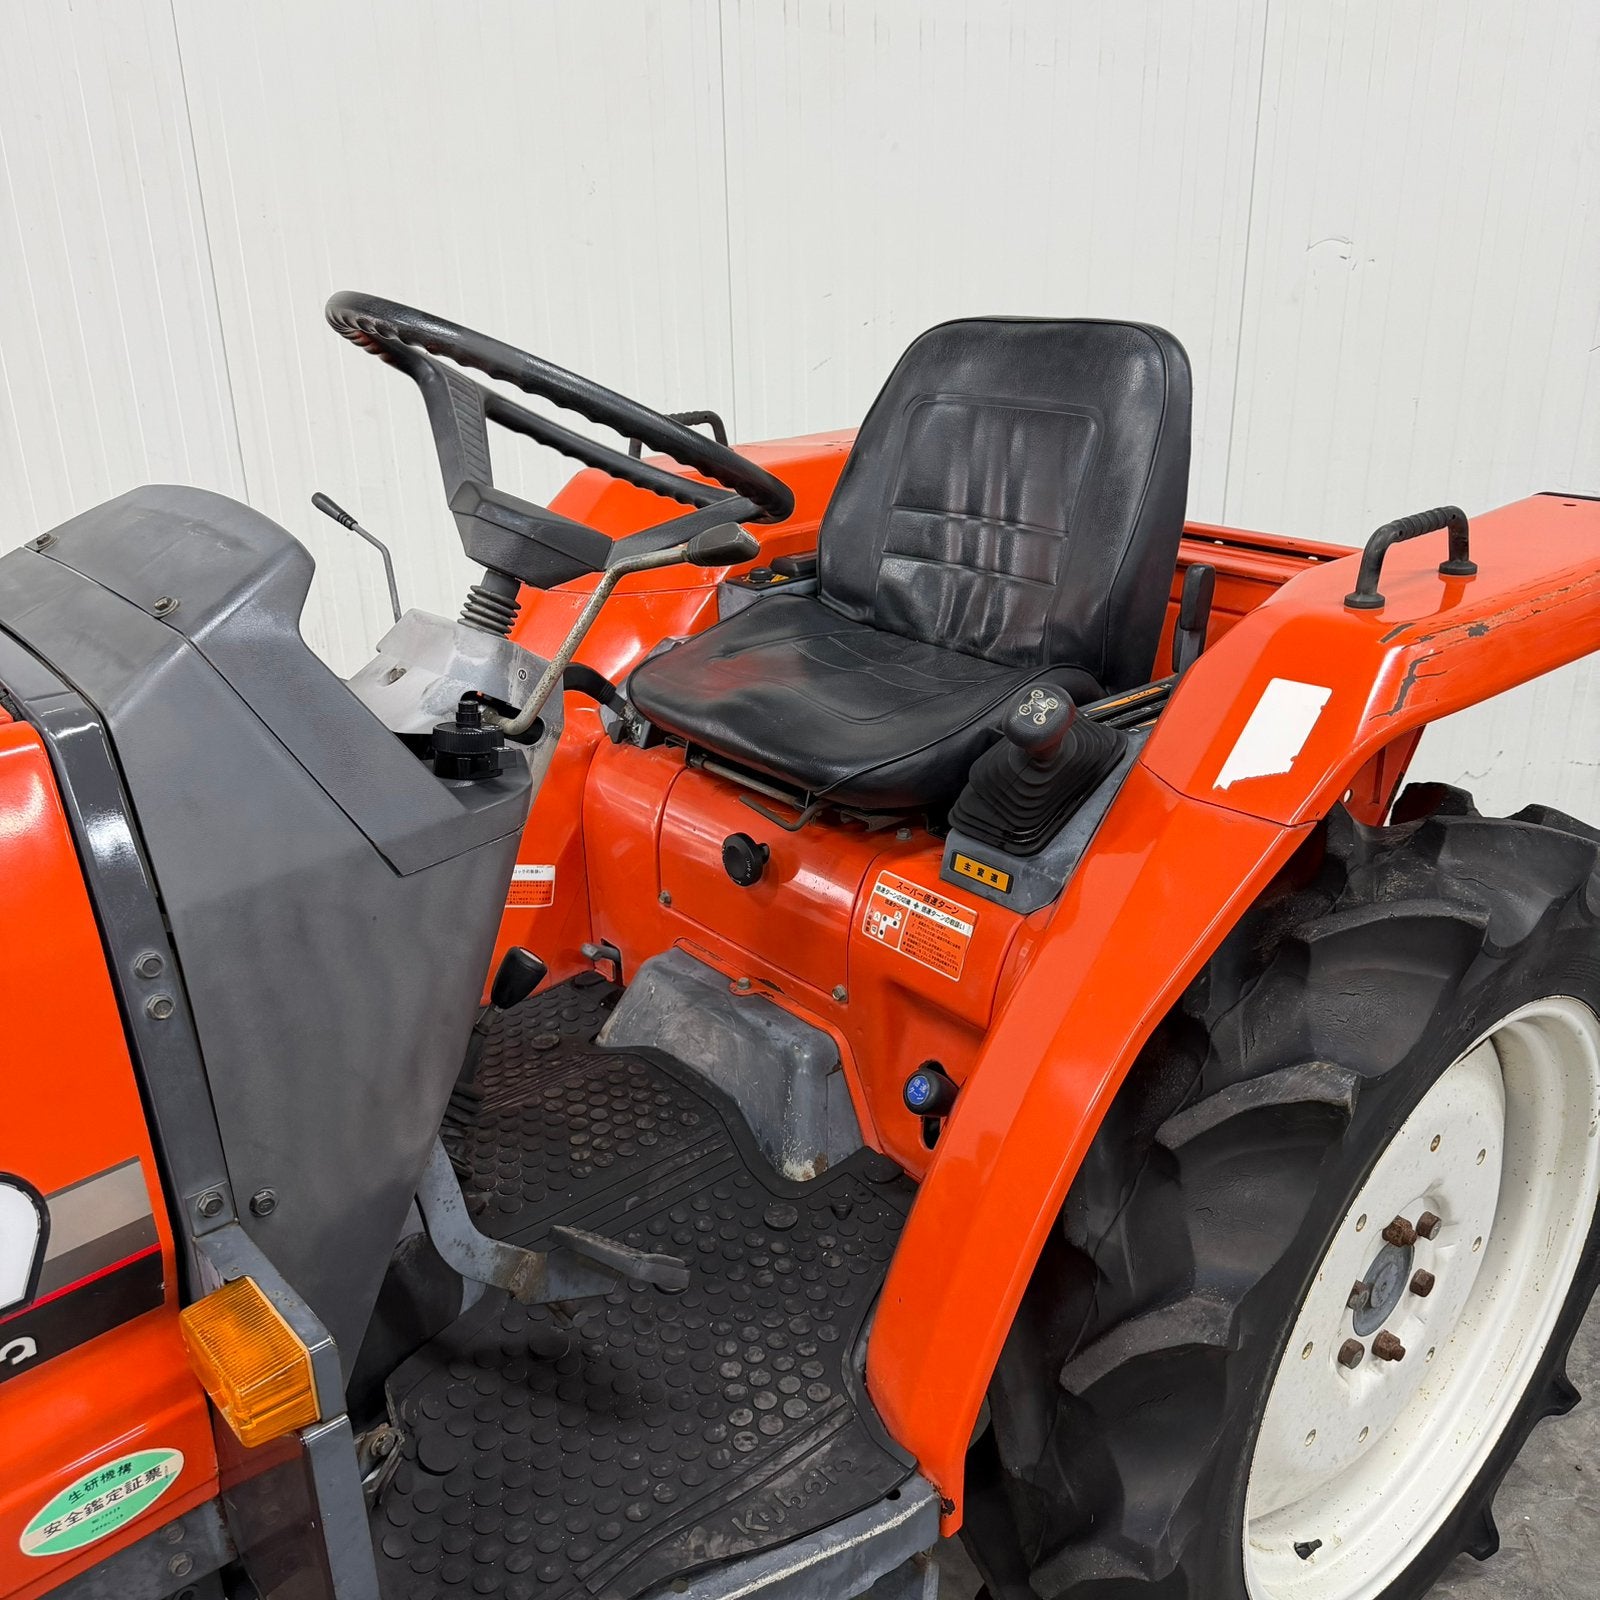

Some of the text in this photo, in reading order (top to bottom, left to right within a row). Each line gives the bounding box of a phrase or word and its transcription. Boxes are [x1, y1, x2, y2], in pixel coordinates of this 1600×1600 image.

[43, 1464, 163, 1539] 安全鑑定証票
[68, 1461, 133, 1504] 生研機構
